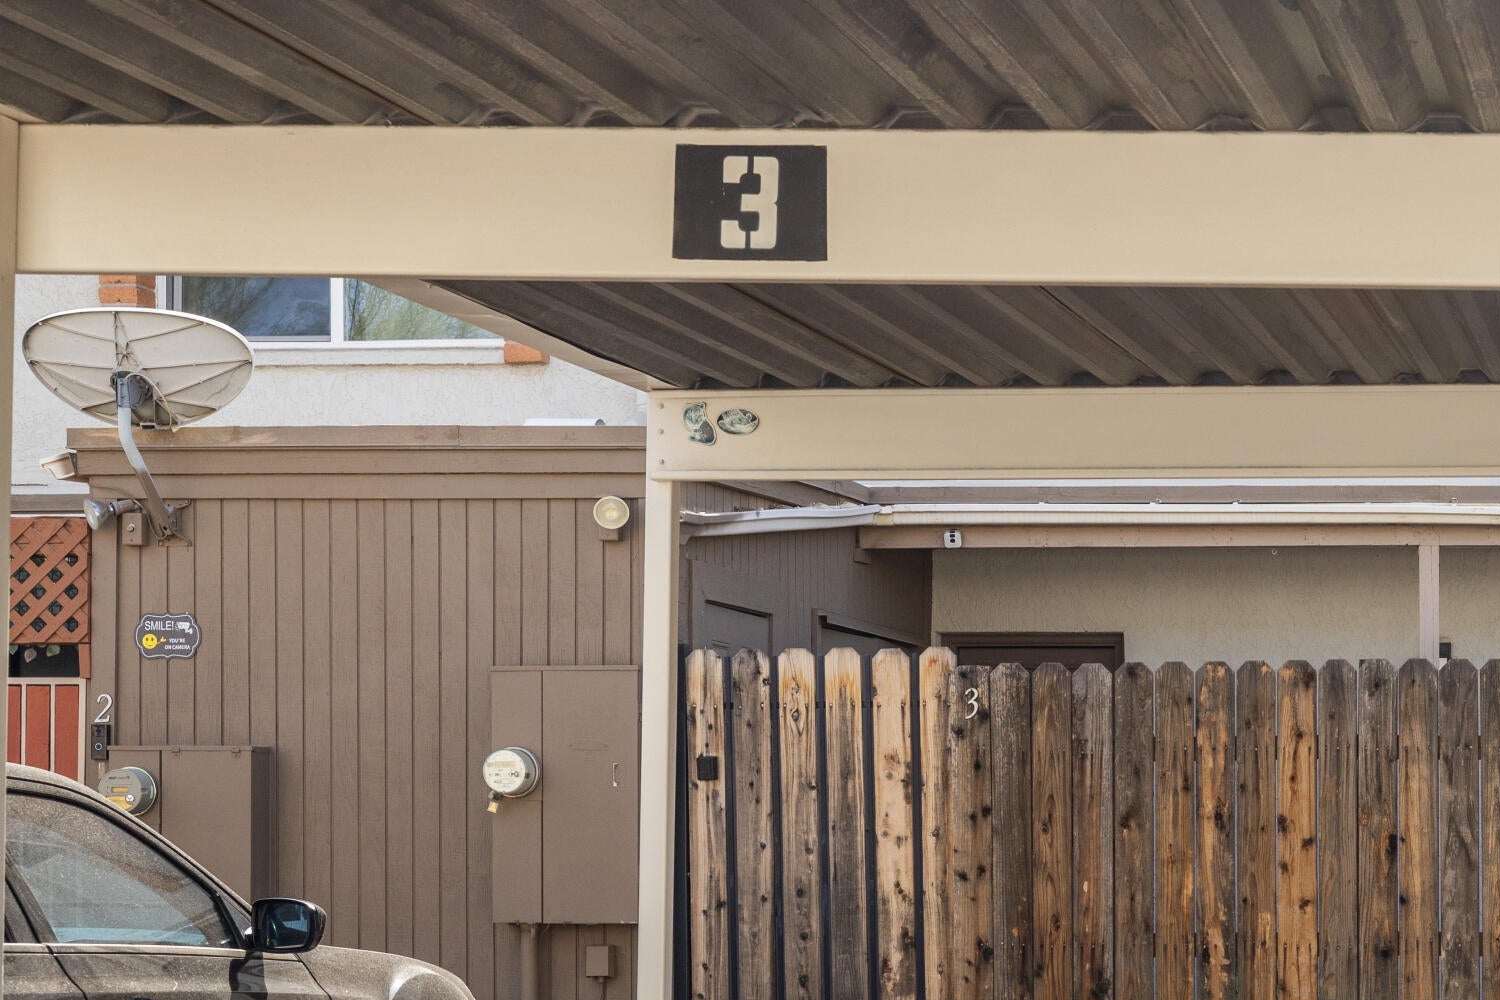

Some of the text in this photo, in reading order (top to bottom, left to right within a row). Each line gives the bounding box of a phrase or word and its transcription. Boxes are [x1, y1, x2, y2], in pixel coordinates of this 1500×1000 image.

[720, 155, 779, 250] 3
[144, 620, 174, 631] SMILE!
[94, 693, 113, 723] 2
[964, 687, 979, 720] 3
